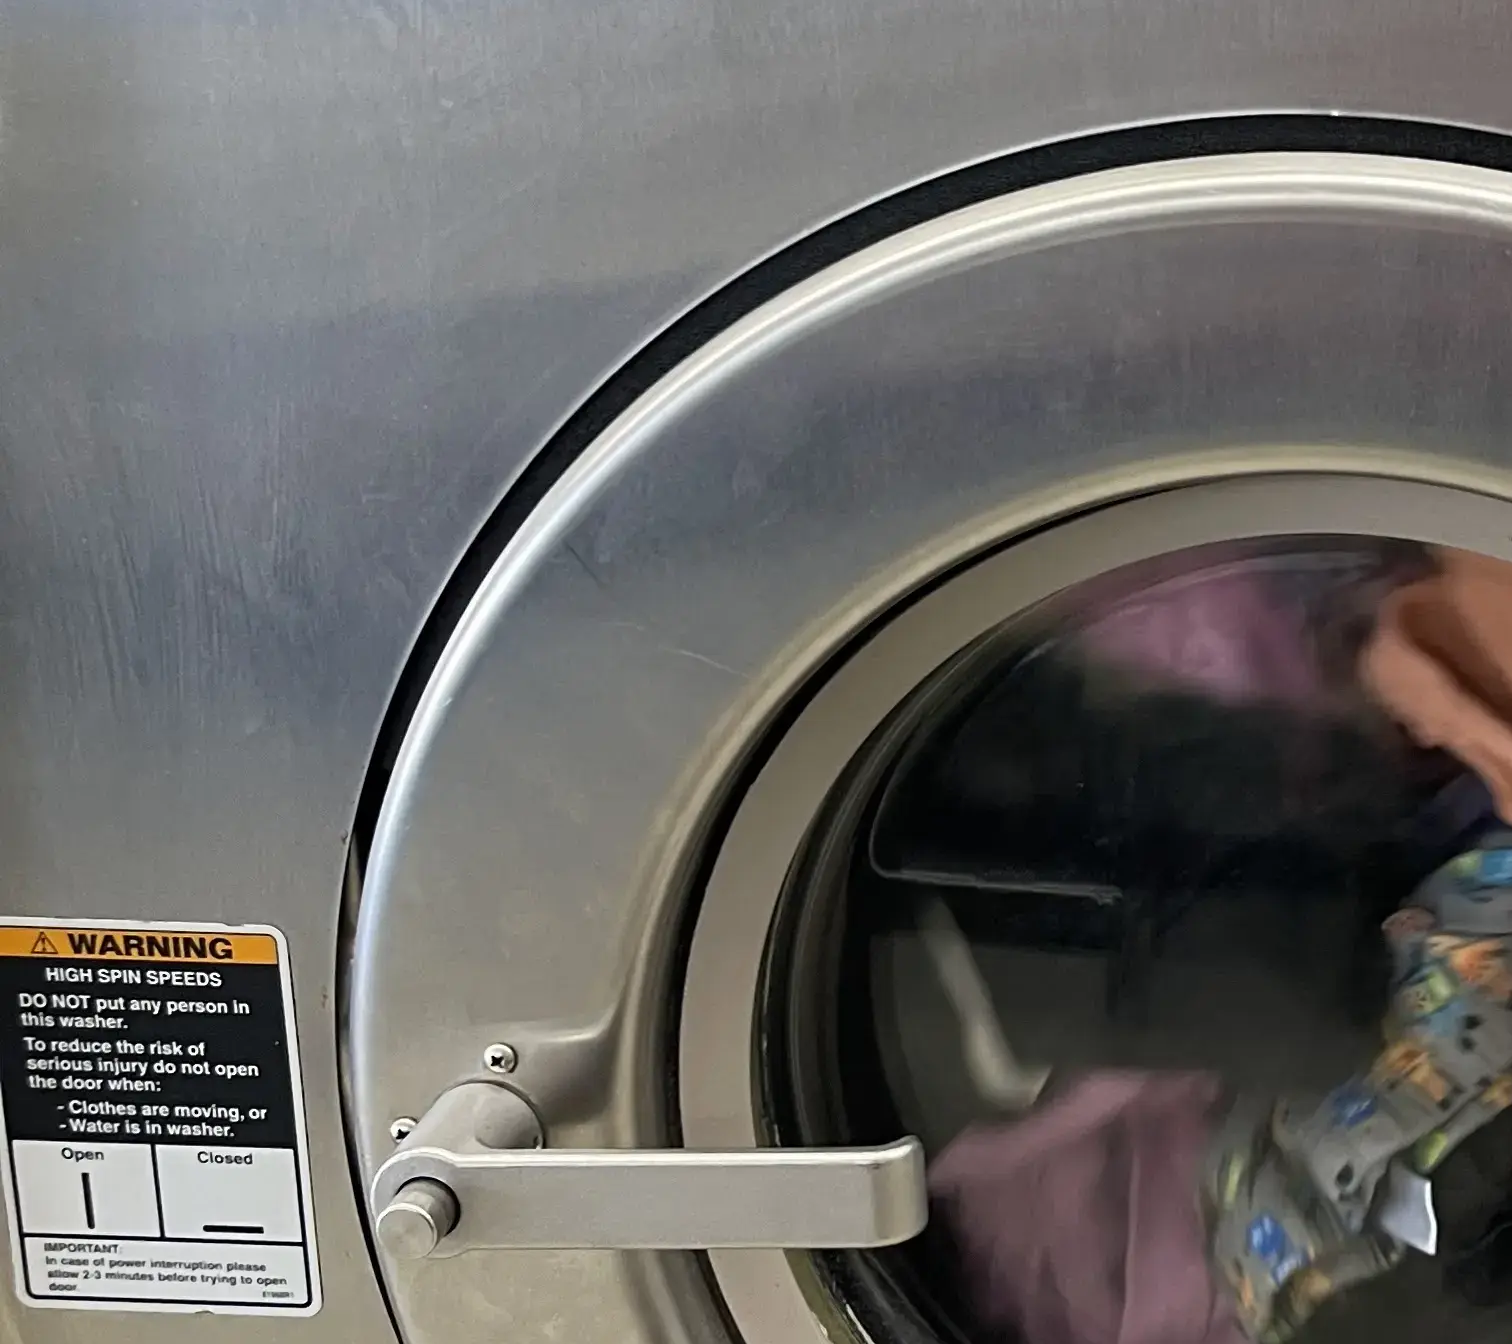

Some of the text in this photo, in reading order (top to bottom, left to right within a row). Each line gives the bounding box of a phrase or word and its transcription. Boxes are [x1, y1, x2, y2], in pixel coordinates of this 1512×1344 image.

[67, 933, 234, 960] WARNING
[46, 967, 222, 987] HIGH SPIN SPEEDS
[19, 993, 250, 1015] DO NOT put any person in
[21, 1013, 129, 1029] this washer.
[24, 1037, 205, 1056] To reduce the risk of
[27, 1057, 259, 1079] serious injury do not open
[29, 1075, 161, 1092] the door when:
[68, 1099, 137, 1117] Clothes
[142, 1104, 169, 1117] are
[175, 1104, 244, 1121] moving,
[249, 1107, 267, 1120] or
[69, 1119, 119, 1133] Water
[125, 1121, 140, 1134] is
[145, 1121, 161, 1135] in
[167, 1122, 235, 1137] washer.
[61, 1147, 104, 1162] Open
[197, 1151, 253, 1165] Closed
[46, 1256, 266, 1273] In case of power interruption please
[48, 1270, 79, 1279] allow
[105, 1271, 154, 1281] minutes
[158, 1273, 197, 1283] before
[201, 1274, 237, 1286] trying
[240, 1276, 252, 1285] to
[256, 1277, 287, 1288] open
